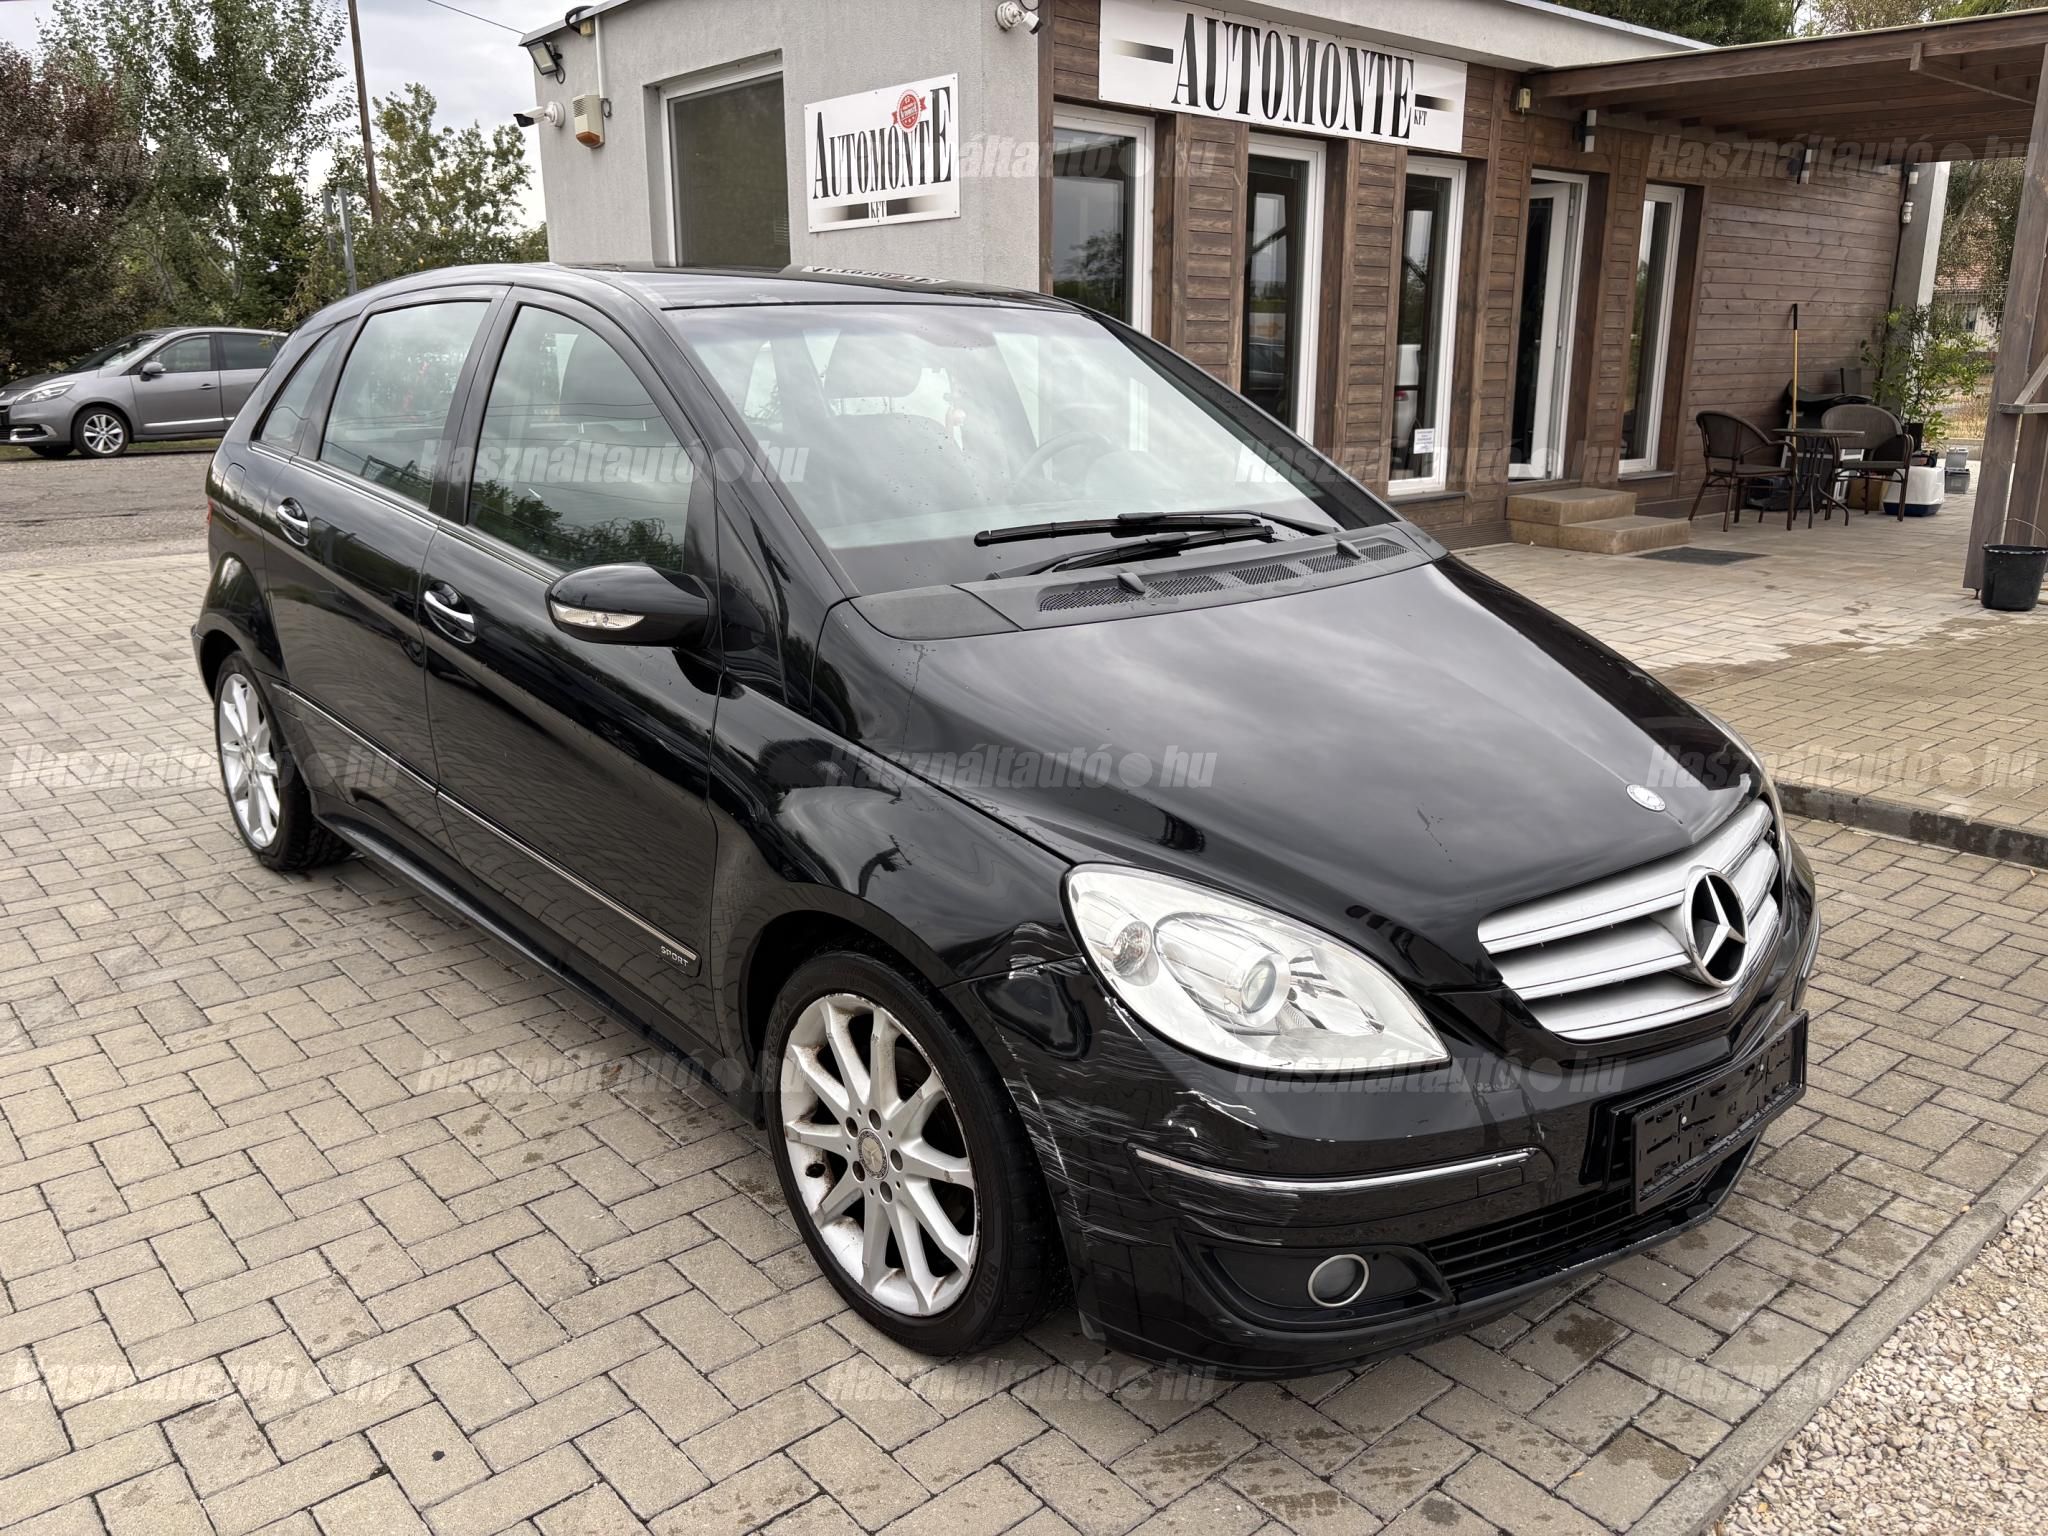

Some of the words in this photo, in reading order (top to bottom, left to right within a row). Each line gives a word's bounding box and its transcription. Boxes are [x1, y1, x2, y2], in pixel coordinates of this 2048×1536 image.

[1171, 13, 1414, 139] AUTOMONTE
[1414, 109, 1427, 127] KFT
[813, 86, 952, 200] AUTOMONTE
[870, 201, 886, 219] KFT
[660, 945, 689, 967] SPORT
